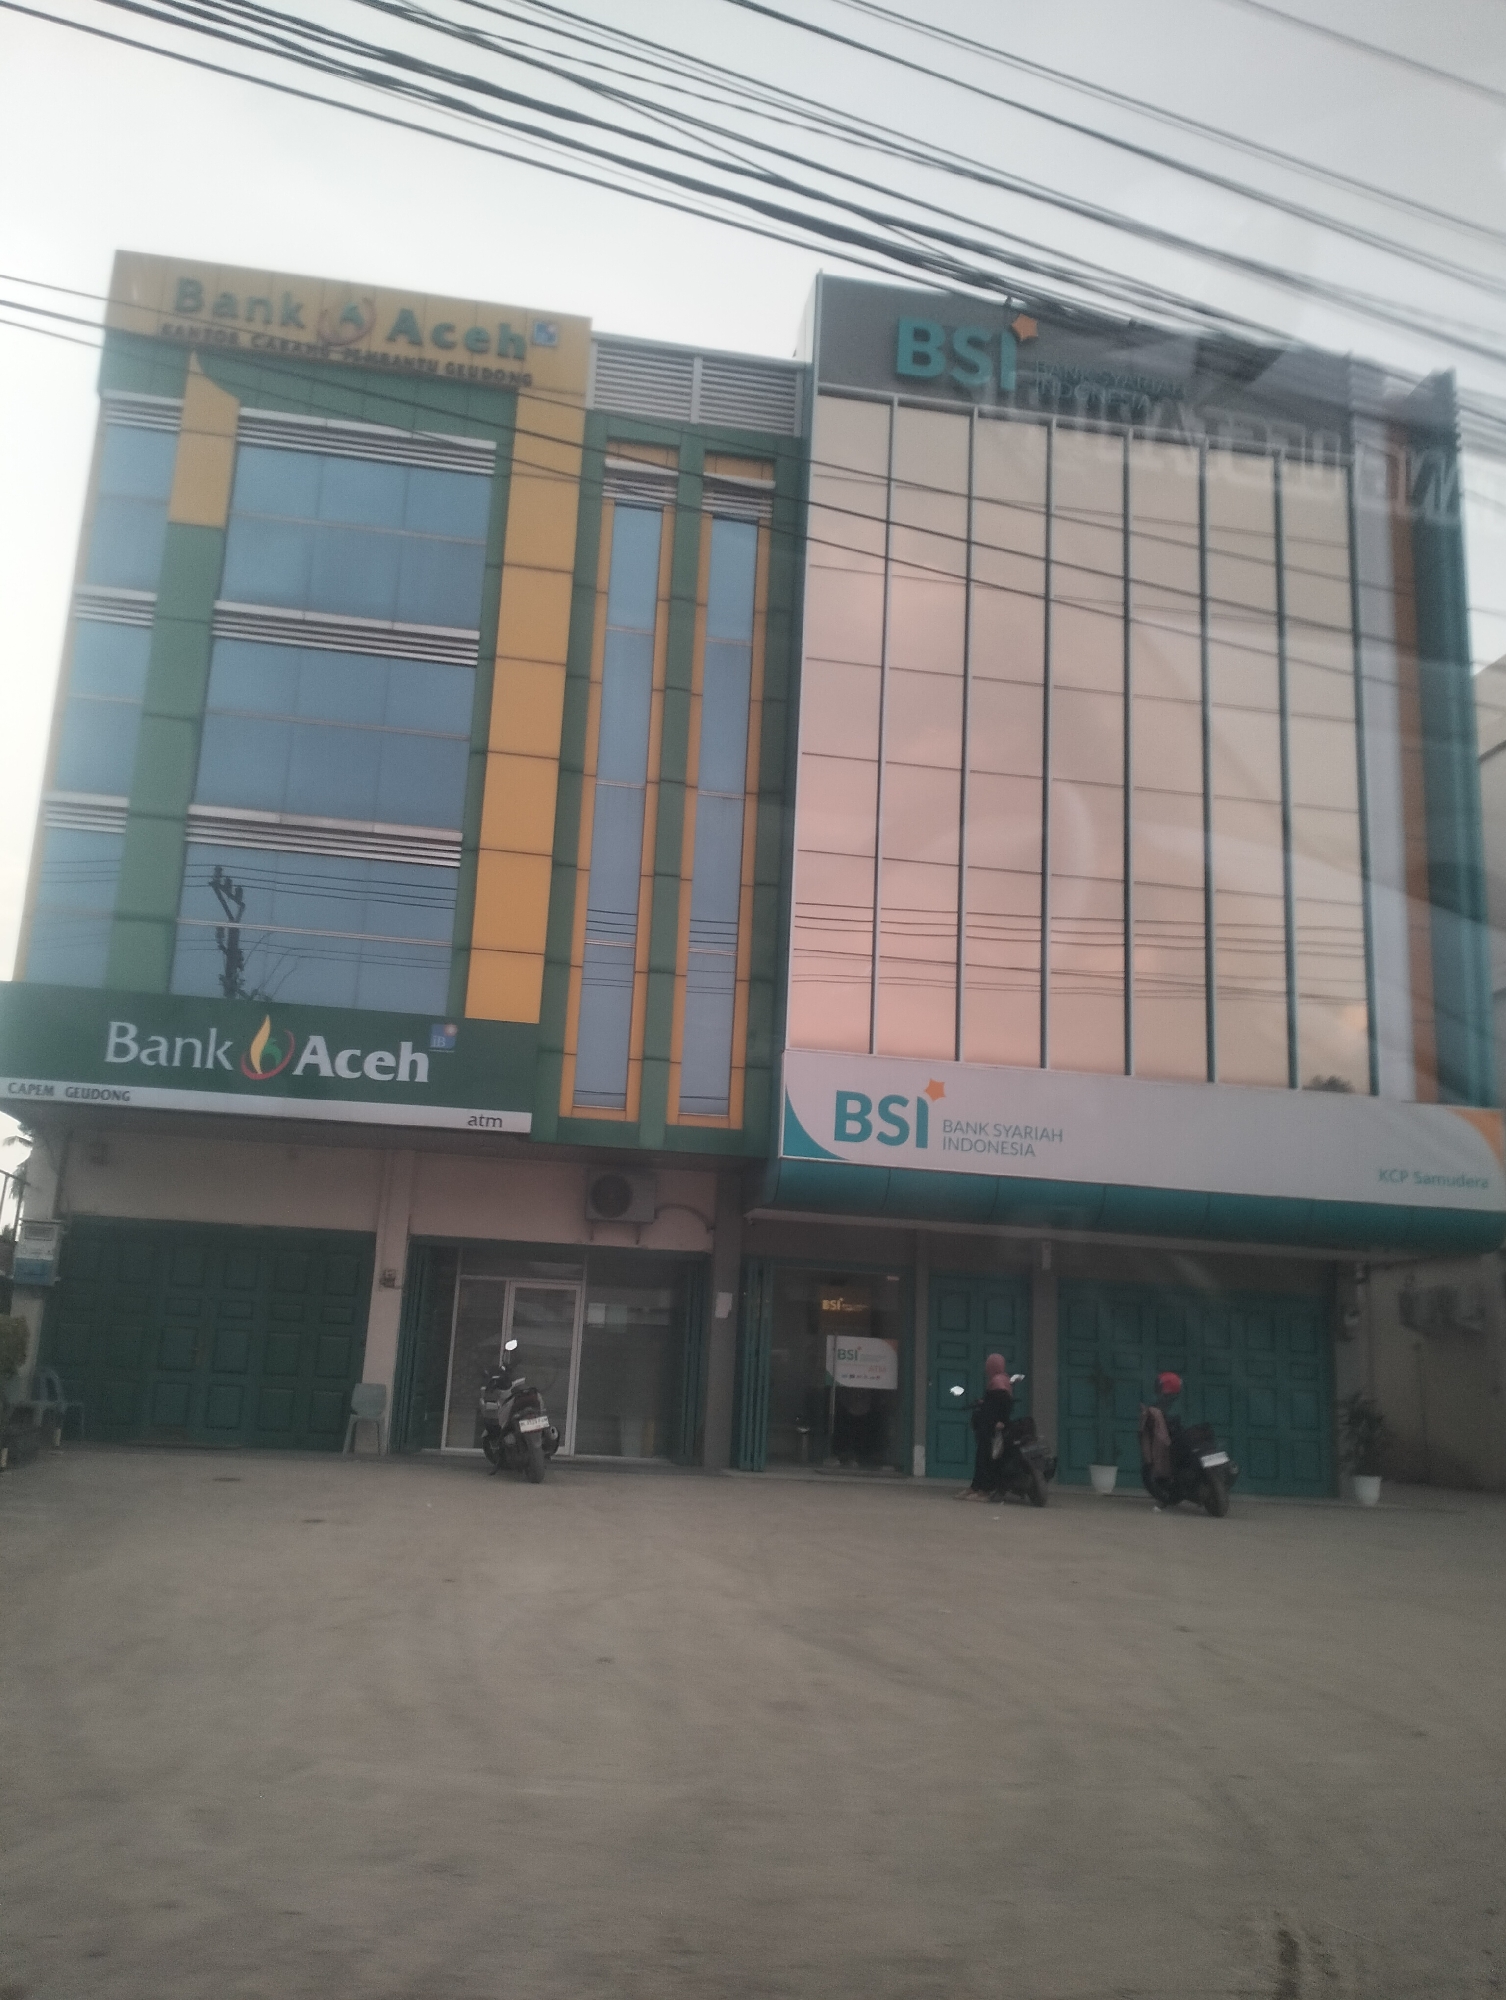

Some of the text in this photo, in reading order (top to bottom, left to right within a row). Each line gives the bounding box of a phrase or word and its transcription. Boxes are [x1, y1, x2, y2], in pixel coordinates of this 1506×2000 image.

[177, 278, 527, 362] Bank Aceh
[896, 316, 1018, 390] BSI
[103, 1020, 430, 1083] Bank Aceh
[7, 1081, 131, 1103] CAPEM GEUDONG
[467, 1113, 503, 1129] atm
[833, 1089, 930, 1149] BSI
[942, 1119, 1063, 1144] BANK SYARIAH
[942, 1136, 1037, 1157] INDONESIA
[1379, 1168, 1489, 1190] KCP Samudera
[837, 1348, 858, 1361] BSI
